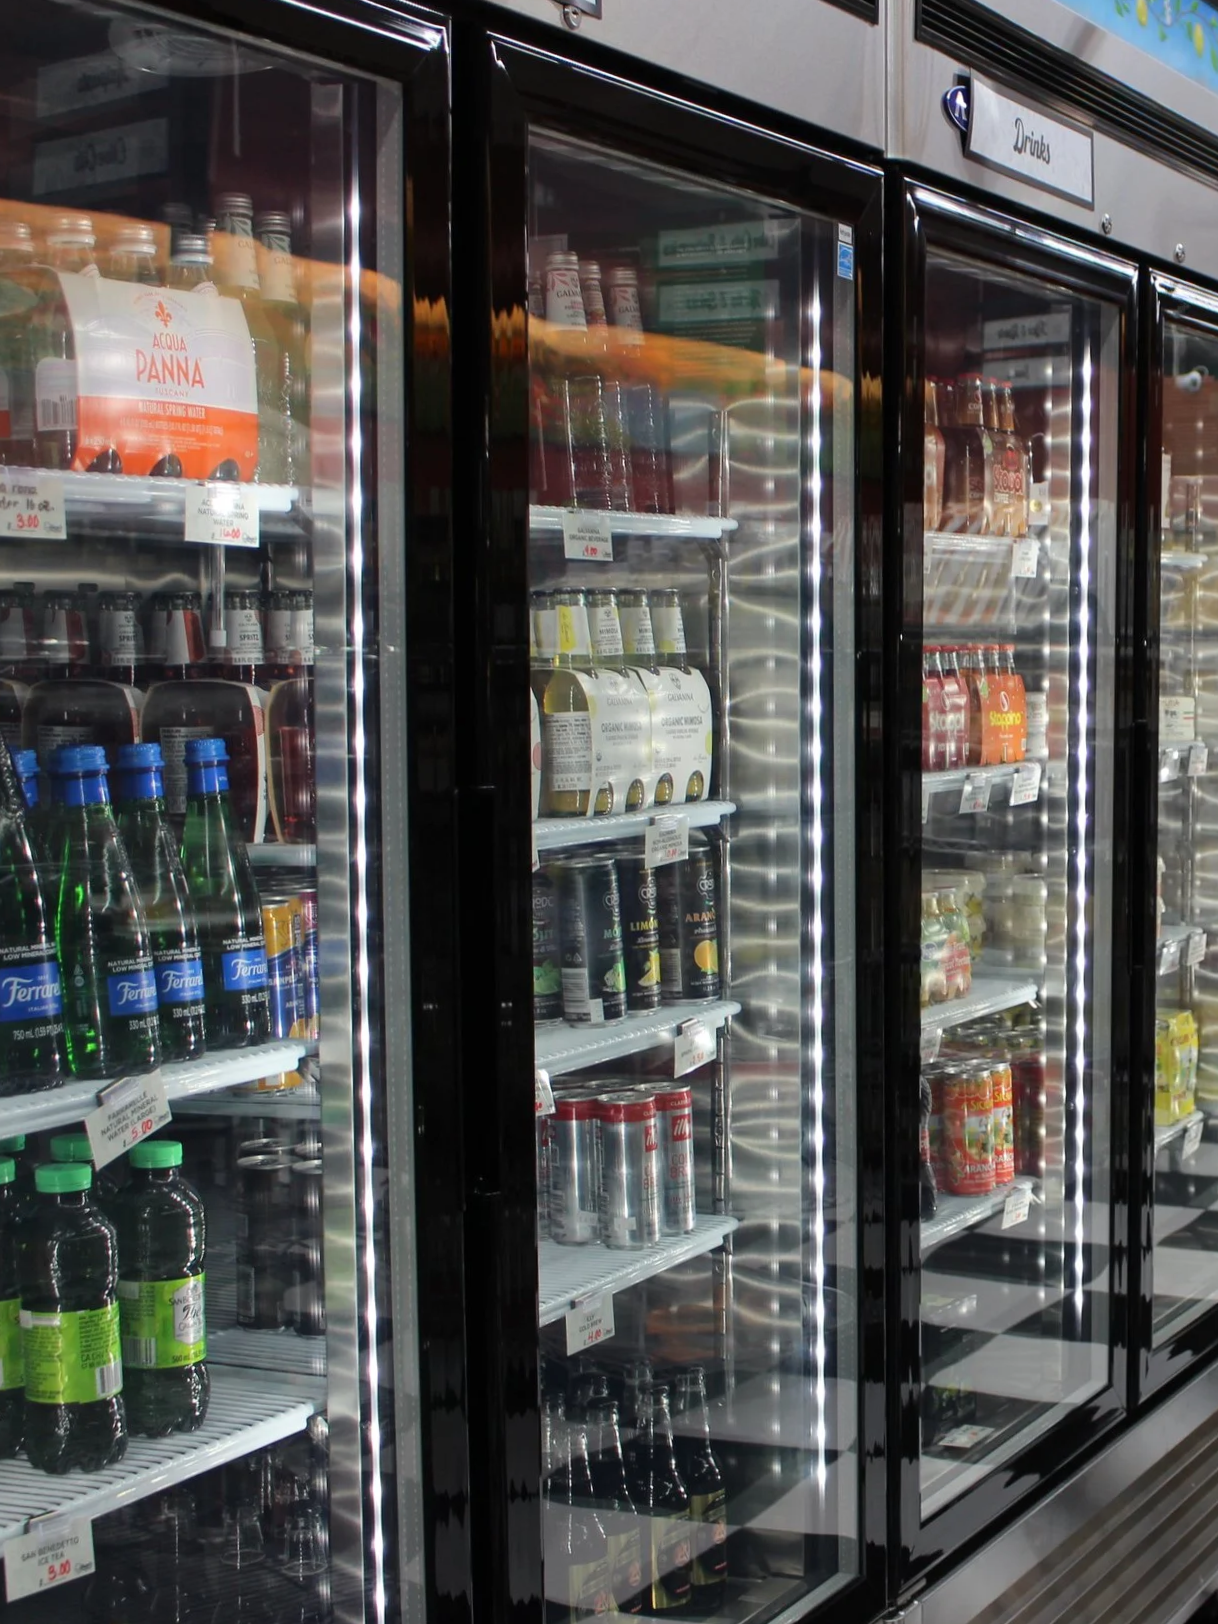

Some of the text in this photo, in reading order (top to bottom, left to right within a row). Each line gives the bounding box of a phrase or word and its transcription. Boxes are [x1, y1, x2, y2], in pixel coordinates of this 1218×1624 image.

[1013, 117, 1050, 165] Drinks
[153, 332, 187, 352] ACQUA
[135, 348, 205, 389] PANNA
[155, 388, 189, 398] TUSCANY
[138, 401, 206, 419] NATURAL SPRING WATER
[213, 519, 234, 527] WATER
[667, 693, 695, 702] GALVANINA
[661, 716, 703, 727] ORGANIC MIMOSA
[601, 722, 624, 732] ORGANIC
[3, 953, 20, 961] LOW
[154, 948, 181, 956] NATURAL
[108, 959, 135, 967] NATURAL
[158, 954, 173, 962] LOW
[242, 994, 251, 1004] 330
[172, 1008, 183, 1018] 330
[129, 1020, 139, 1030] 330
[13, 1030, 24, 1040] 750
[25, 1028, 34, 1039] mL
[100, 1094, 159, 1137] NATURAL MINERAL
[107, 1105, 157, 1142] WATER (LARGE)
[131, 1119, 154, 1139] 5.00
[21, 1536, 79, 1562] SAN BENEDETTO
[37, 1551, 65, 1566] ICE TEA
